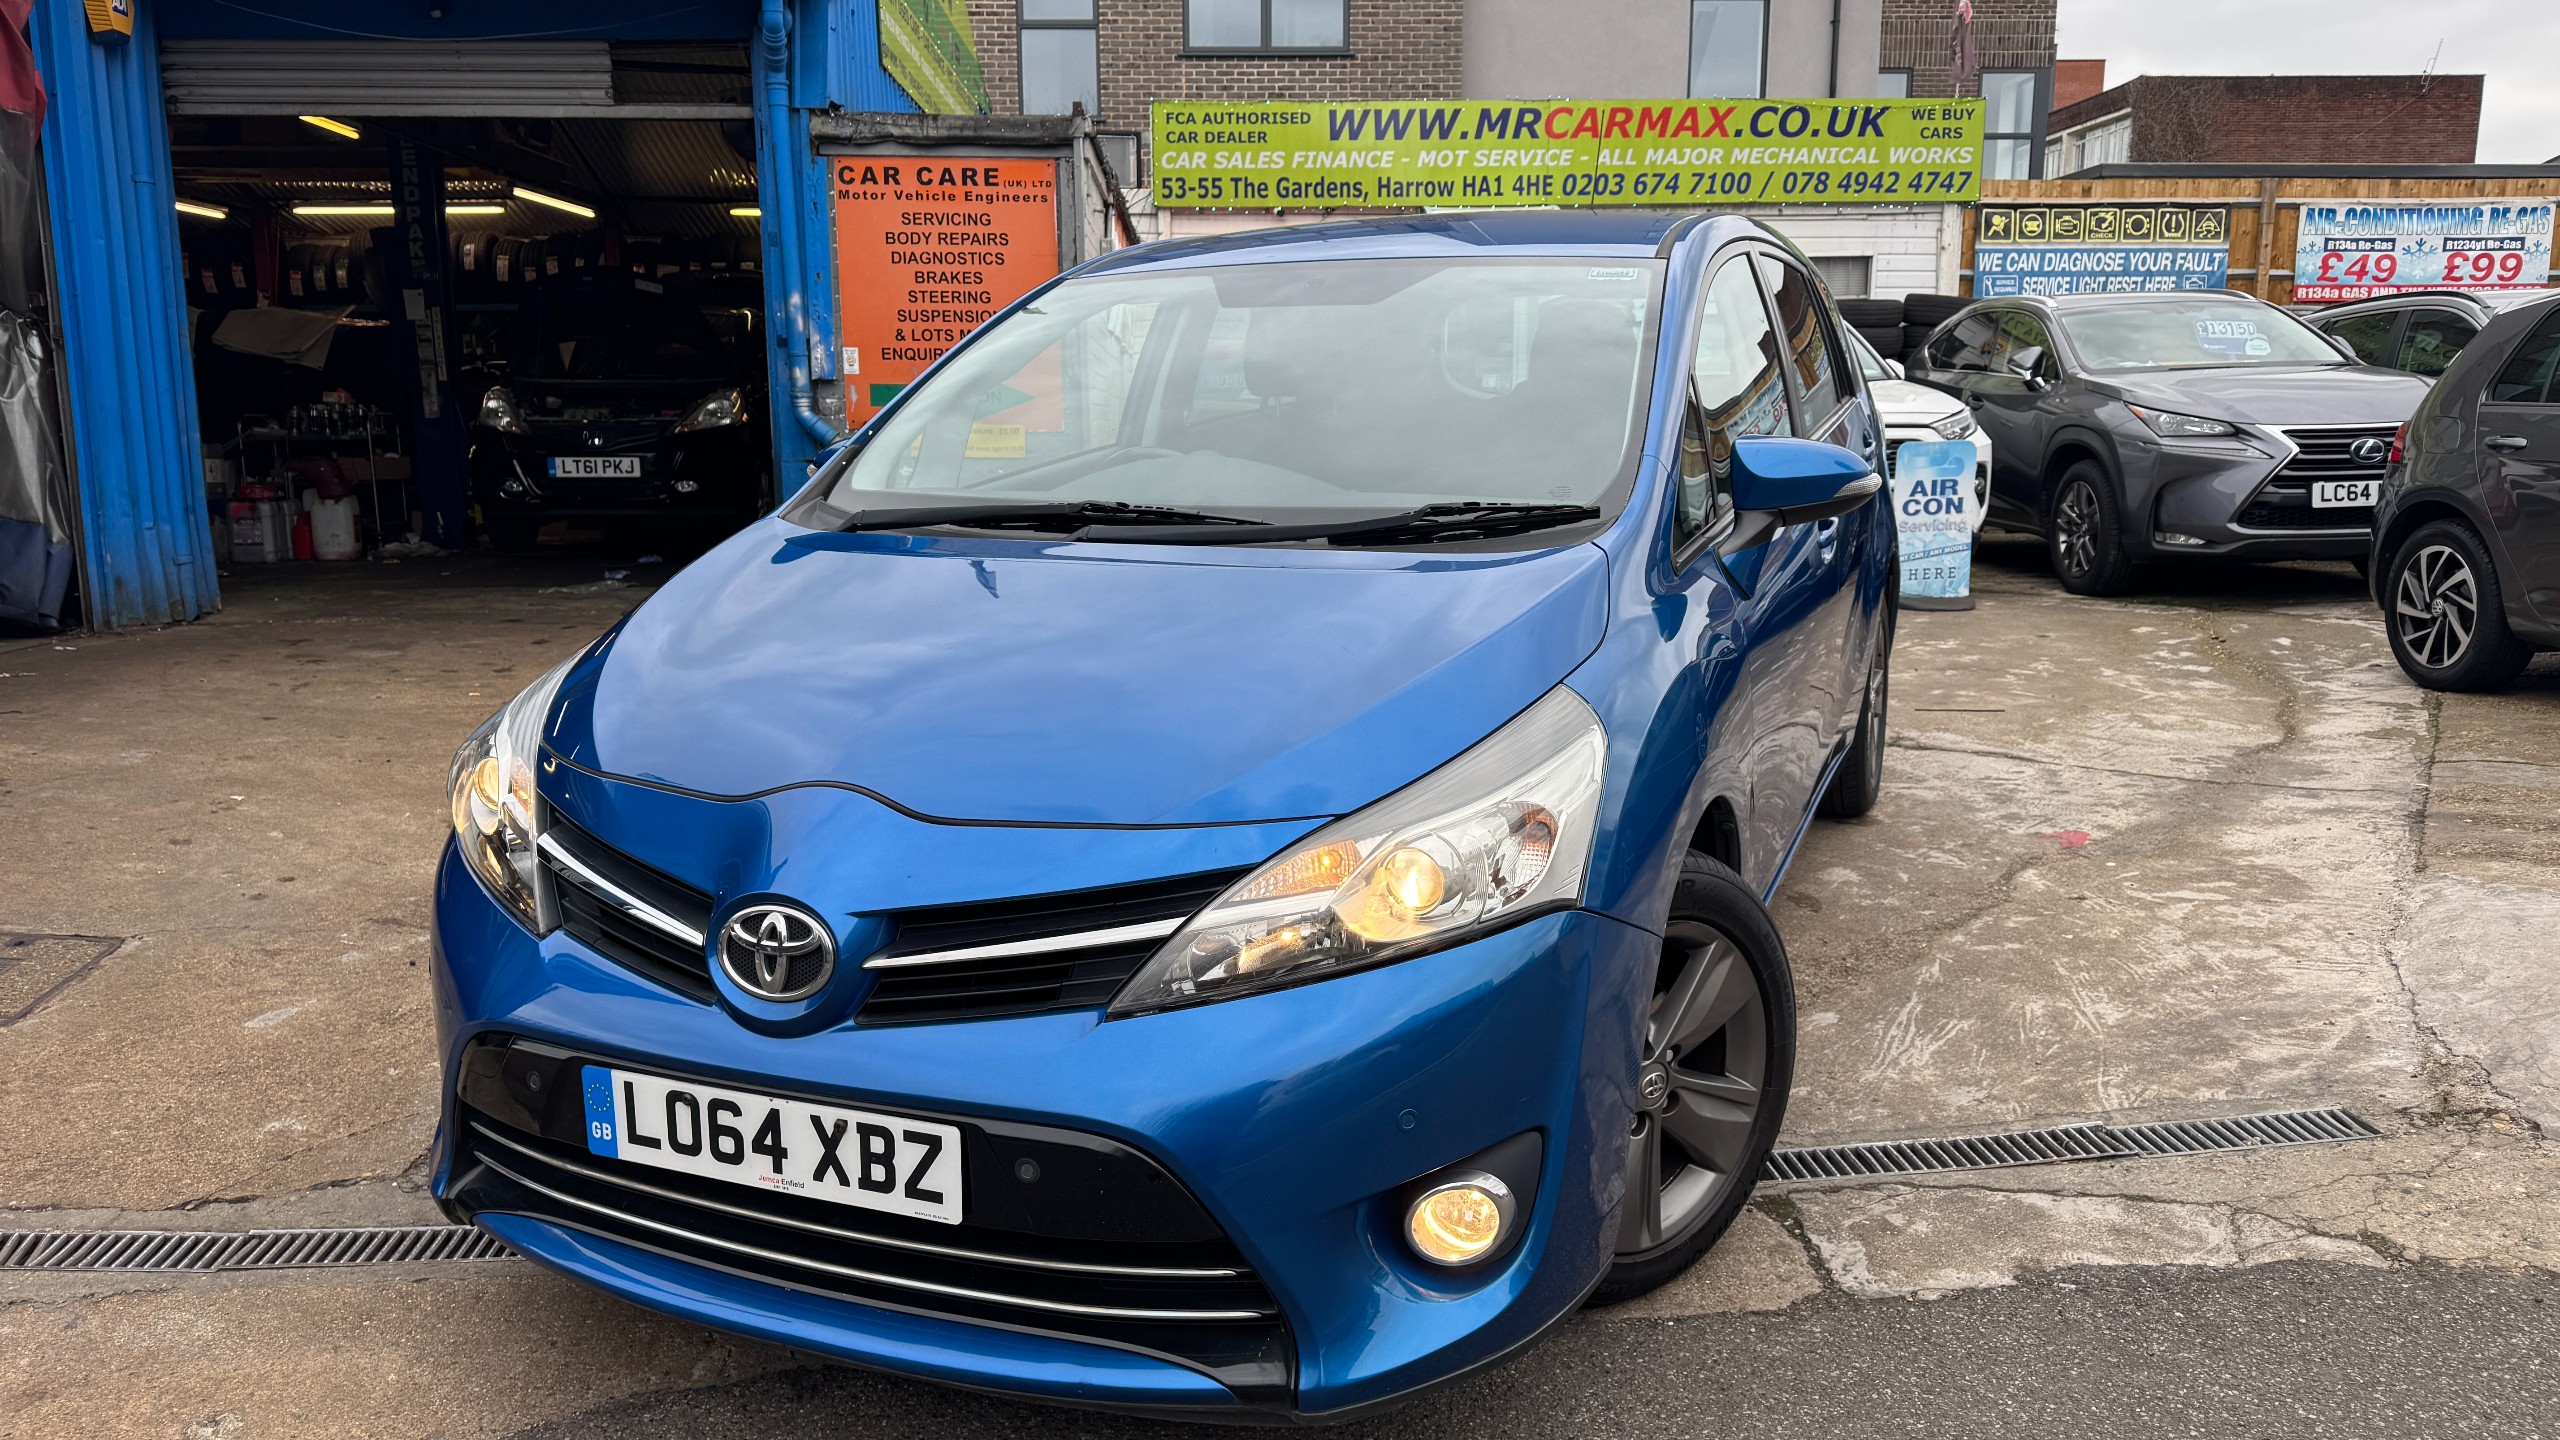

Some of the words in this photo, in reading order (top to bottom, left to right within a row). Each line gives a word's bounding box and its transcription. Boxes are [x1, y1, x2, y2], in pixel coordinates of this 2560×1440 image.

[1166, 112, 1196, 125] FCA
[1202, 111, 1311, 125] AUTHORISED
[1911, 109, 1938, 122] WE
[1942, 108, 1976, 121] BUY
[1328, 106, 1891, 141] WWW.MRCARMAX.CO.UK
[1166, 131, 1200, 144] CAR
[1205, 131, 1268, 144] DEALER
[1920, 127, 1963, 140] CARS
[1161, 152, 1206, 169] CAR
[1213, 152, 1285, 169] SALES
[1292, 151, 1395, 168] FINANCE
[1417, 150, 1469, 168] MOT
[1474, 149, 1573, 167] SERVICE
[1597, 148, 1636, 166] ALL
[1644, 148, 1723, 165] MAJOR
[1731, 147, 1881, 165] MECHANICAL
[1889, 146, 1974, 164] WORKS
[838, 165, 901, 186] CAR
[916, 167, 999, 187] CARE
[1003, 180, 1027, 189] (UK)
[1032, 180, 1052, 188] LTD
[1161, 177, 1224, 199] 53-55
[1230, 177, 1269, 199] The
[1276, 175, 1369, 202] Gardens,
[1377, 175, 1455, 198] Harrow
[1463, 175, 1503, 197] HA1
[1513, 174, 1554, 196] 4HE
[1562, 173, 1625, 196] 0203
[1633, 172, 1680, 195] 674
[1689, 171, 1752, 194] 7100
[1759, 171, 1775, 198] /
[1782, 171, 1830, 194] 078
[1838, 171, 1900, 194] 4942
[1908, 170, 1973, 194] 4747
[838, 189, 887, 201] Motor
[894, 190, 956, 202] Vehicle
[964, 191, 1048, 205] Engineers
[901, 212, 992, 226] SERVICING
[2303, 207, 2483, 236] AIR-CONDITIONING
[2488, 206, 2551, 235] RE-GAS
[885, 232, 931, 245] BODY
[938, 232, 1009, 246] REPAIRS
[2327, 240, 2357, 250] R134a
[2358, 240, 2393, 251] Re-Gas
[2487, 239, 2522, 250] Re-Gas
[891, 251, 1005, 265] DIAGNOSTICS
[1979, 253, 2004, 271] WE
[2006, 252, 2041, 271] CAN
[2044, 252, 2125, 271] DIAGNOSE
[2129, 252, 2172, 271] YOUR
[2175, 252, 2222, 271] FAULT
[2316, 252, 2398, 283] £49
[2441, 252, 2524, 283] £99
[914, 271, 983, 285] BRAKES
[2022, 276, 2071, 296] SERVICE
[2073, 276, 2106, 294] LIGHT
[2107, 276, 2144, 292] RESET
[2145, 276, 2177, 291] HERE
[2297, 287, 2340, 299] R134a
[2341, 286, 2369, 299] GAS
[2371, 286, 2398, 298] AND
[908, 290, 991, 304] STEERING
[897, 309, 997, 323] SUSPENSIO
[895, 328, 906, 341] &
[911, 328, 954, 341] LOTS
[881, 347, 950, 361] ENQUIR
[561, 459, 598, 474] LT61
[602, 459, 634, 474] PKJ
[1909, 478, 1959, 498] AIR
[2320, 483, 2372, 502] LC64
[1902, 497, 1964, 516] CON
[1899, 518, 1968, 534] Servicing
[1944, 545, 1969, 553] MODEL
[1908, 567, 1957, 580] HERE
[591, 1121, 613, 1141] GB
[623, 1080, 788, 1175] LO64
[810, 1114, 944, 1205] XBZ
[781, 1178, 805, 1189] Enfield
